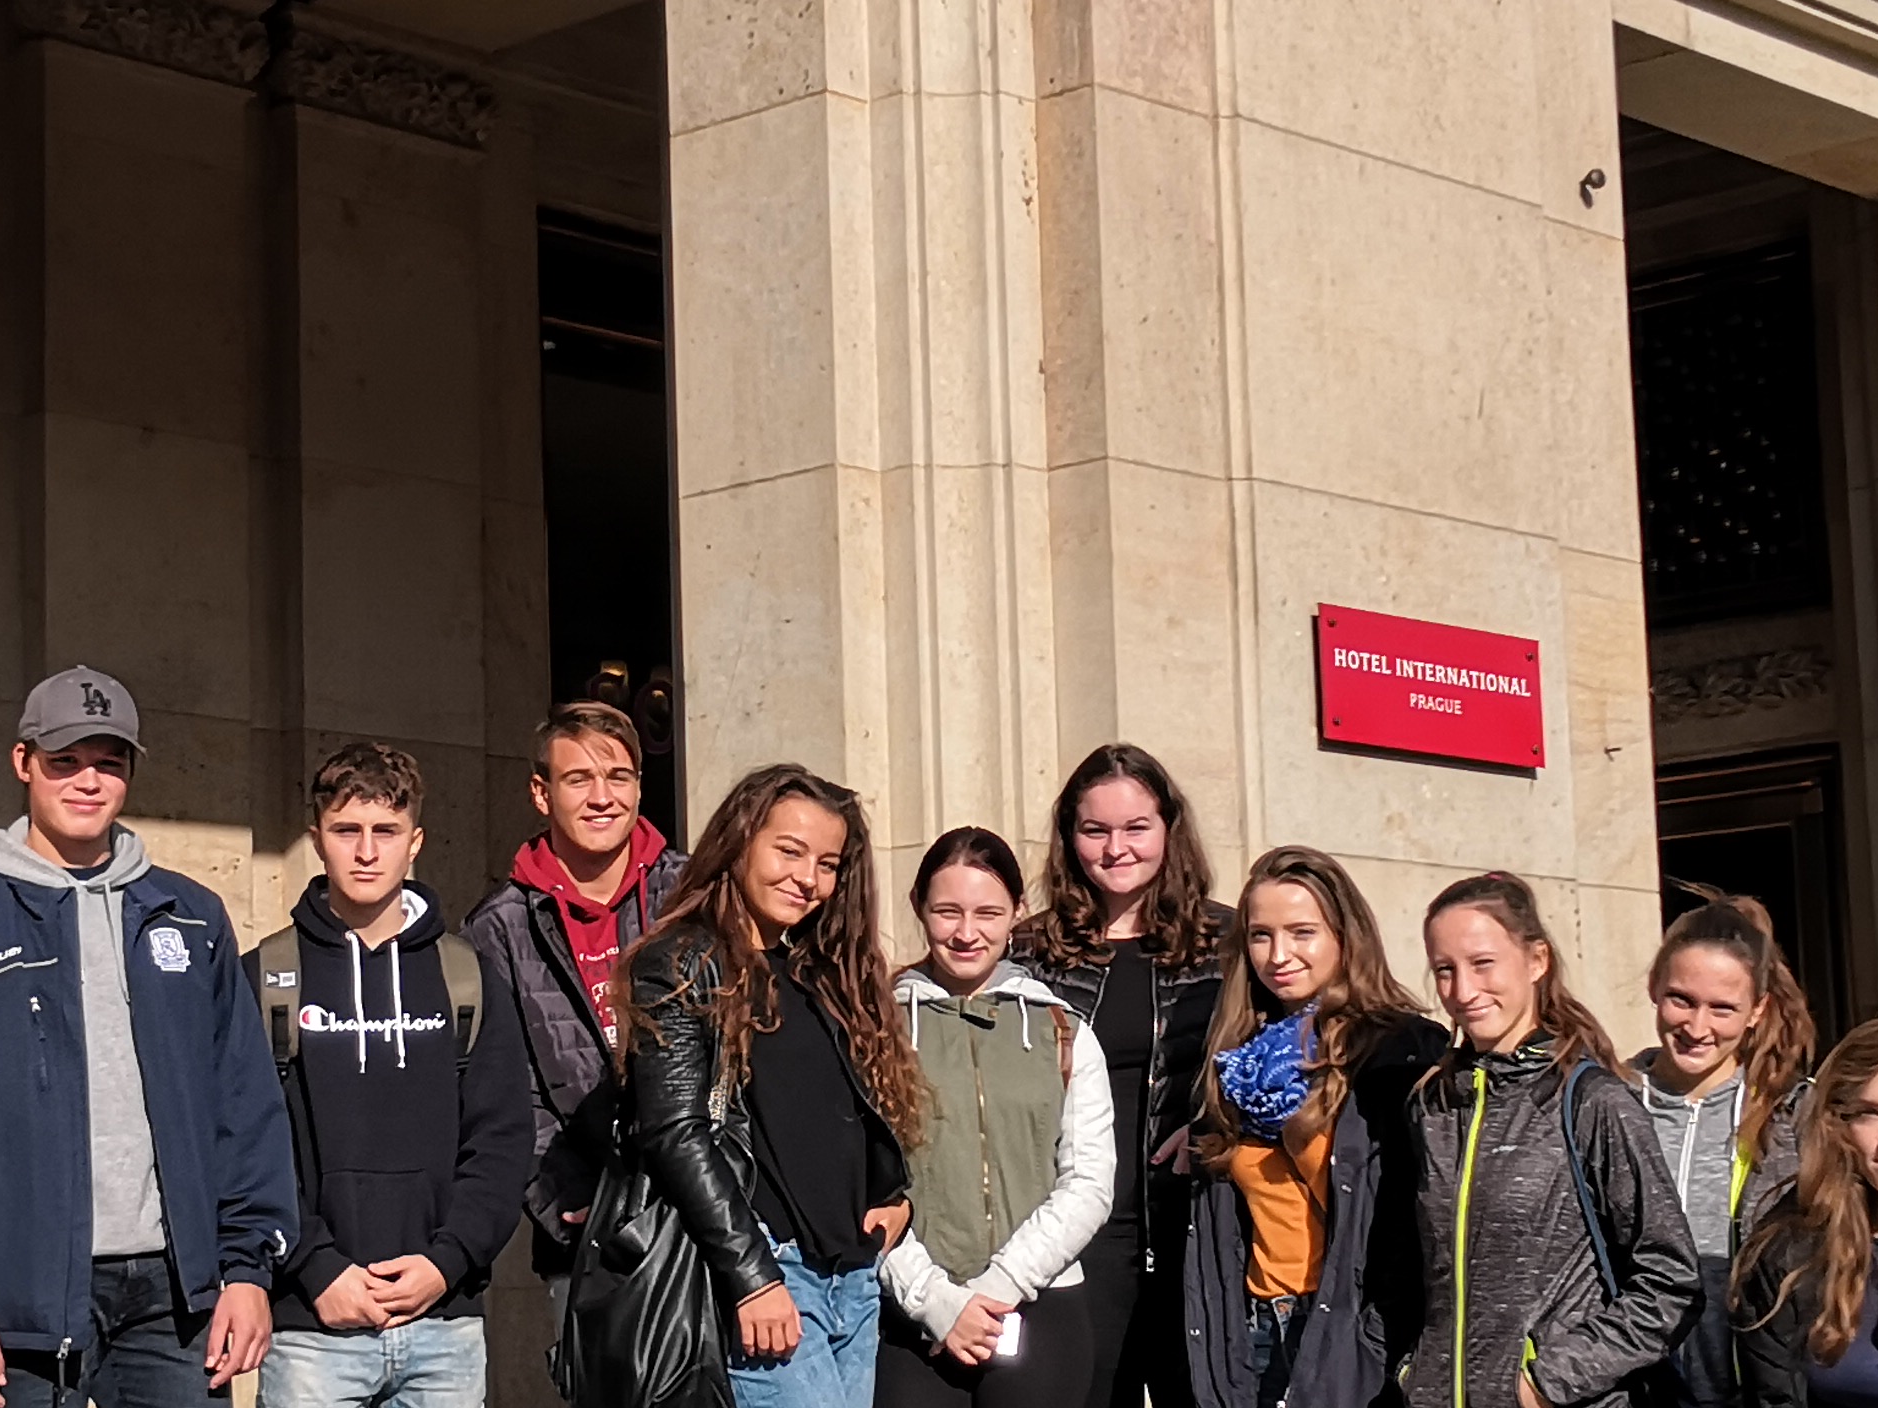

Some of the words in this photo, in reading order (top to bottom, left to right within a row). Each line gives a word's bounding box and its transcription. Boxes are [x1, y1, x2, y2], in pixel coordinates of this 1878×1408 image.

[1334, 647, 1392, 675] HOTEL
[1395, 658, 1532, 698] INTERNATIONAL
[80, 682, 112, 717] LA
[1409, 692, 1463, 715] PRAGUE
[299, 1004, 446, 1042] Champion
